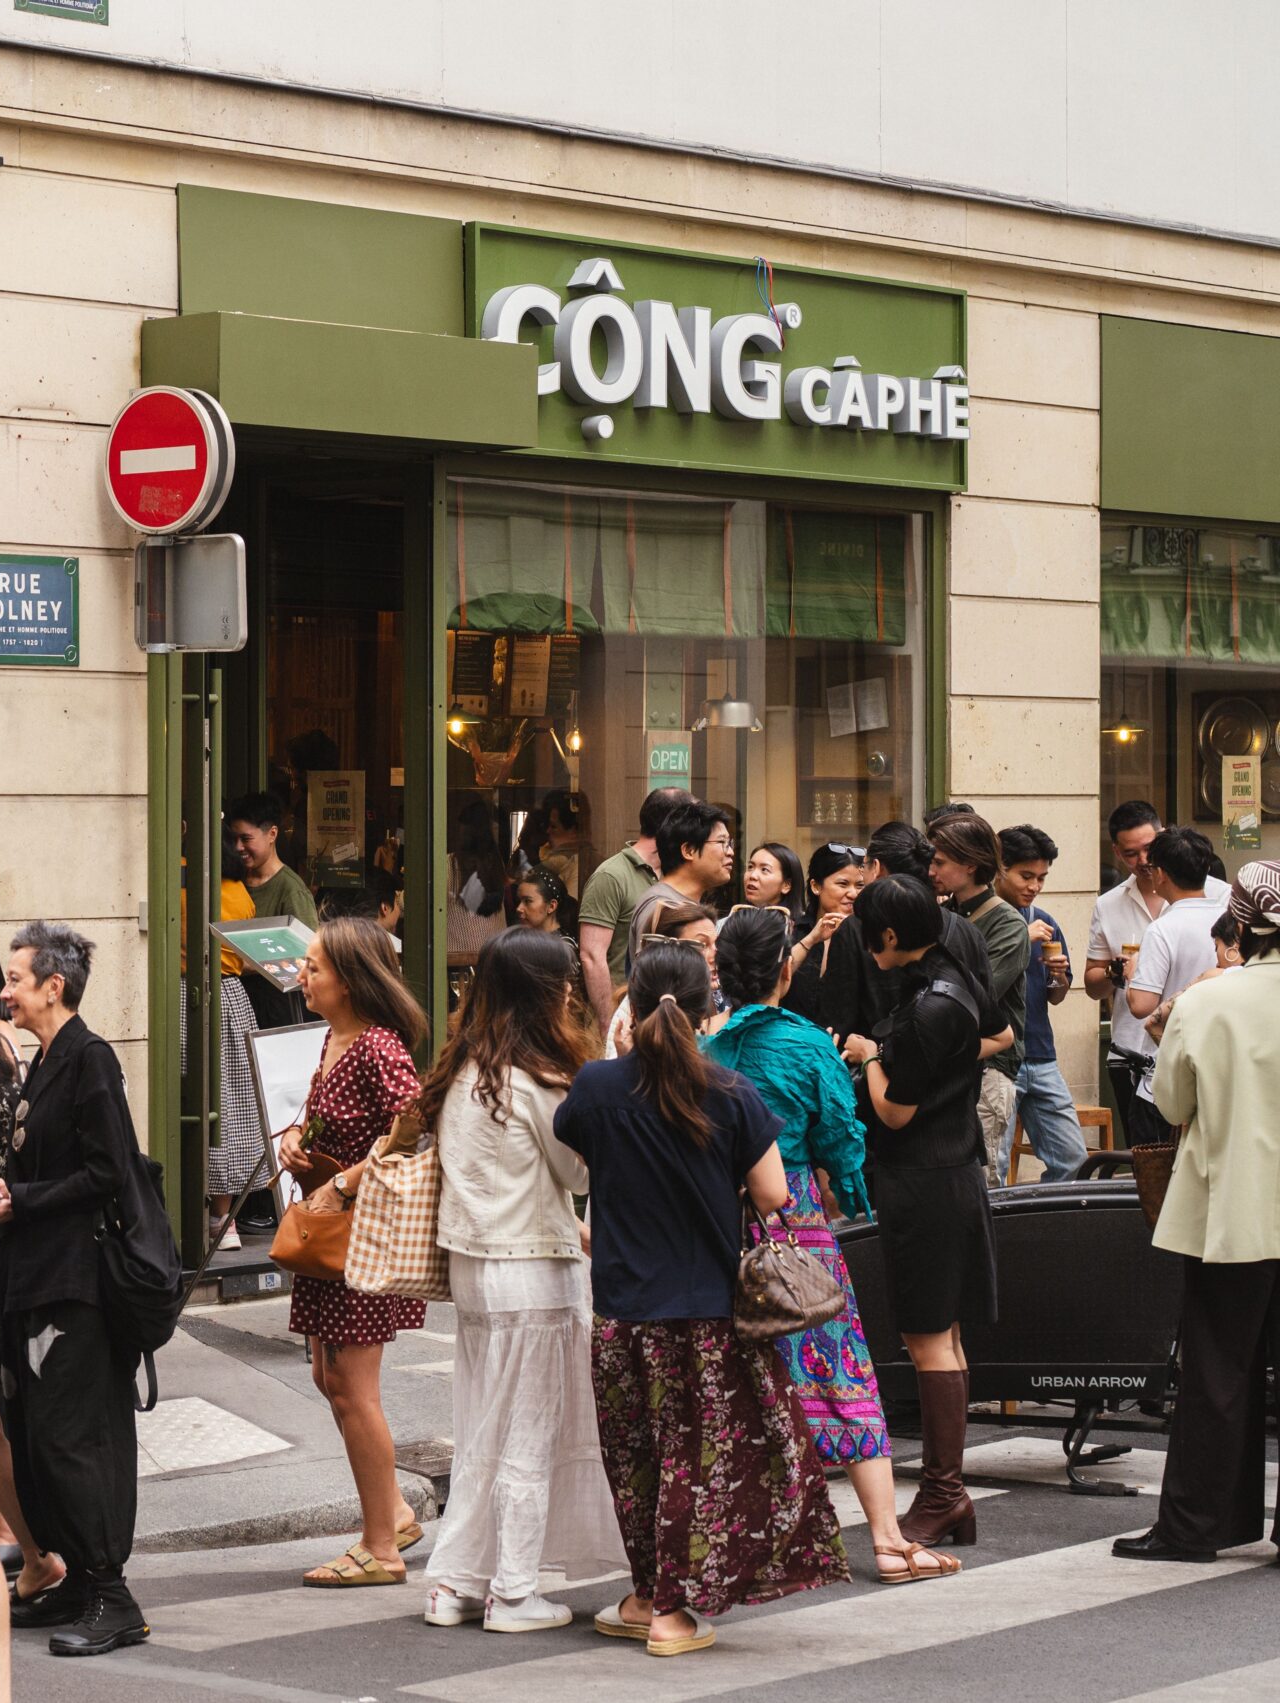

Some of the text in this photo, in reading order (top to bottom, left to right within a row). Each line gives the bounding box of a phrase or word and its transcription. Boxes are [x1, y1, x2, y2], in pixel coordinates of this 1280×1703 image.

[650, 750, 689, 770] OPEN
[1233, 771, 1250, 783] GRAND
[325, 790, 348, 804] GRAND
[1231, 785, 1252, 796] OPENING
[322, 807, 351, 821] OPENING
[1031, 1376, 1147, 1387] URBAN ARROW
